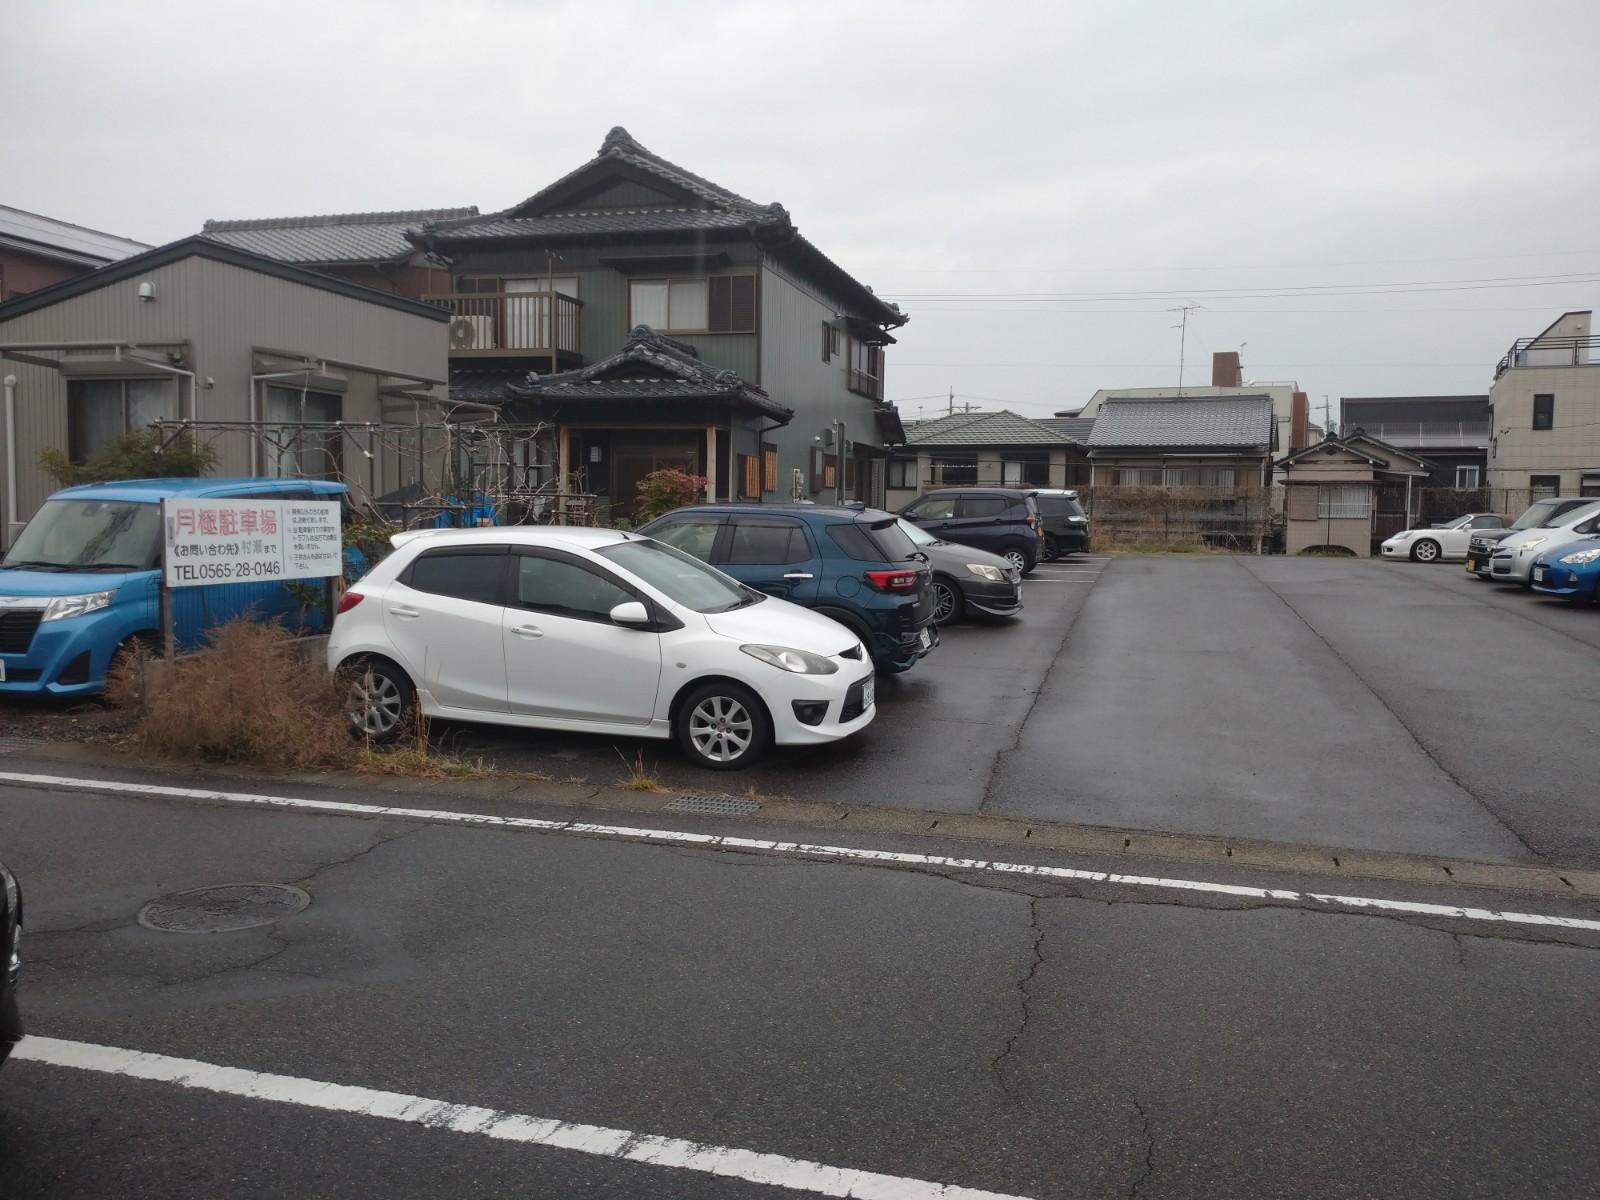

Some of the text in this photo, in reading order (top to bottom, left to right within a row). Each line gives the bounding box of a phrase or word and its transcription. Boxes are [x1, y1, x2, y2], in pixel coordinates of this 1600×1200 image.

[176, 508, 277, 536] 月極駐車場
